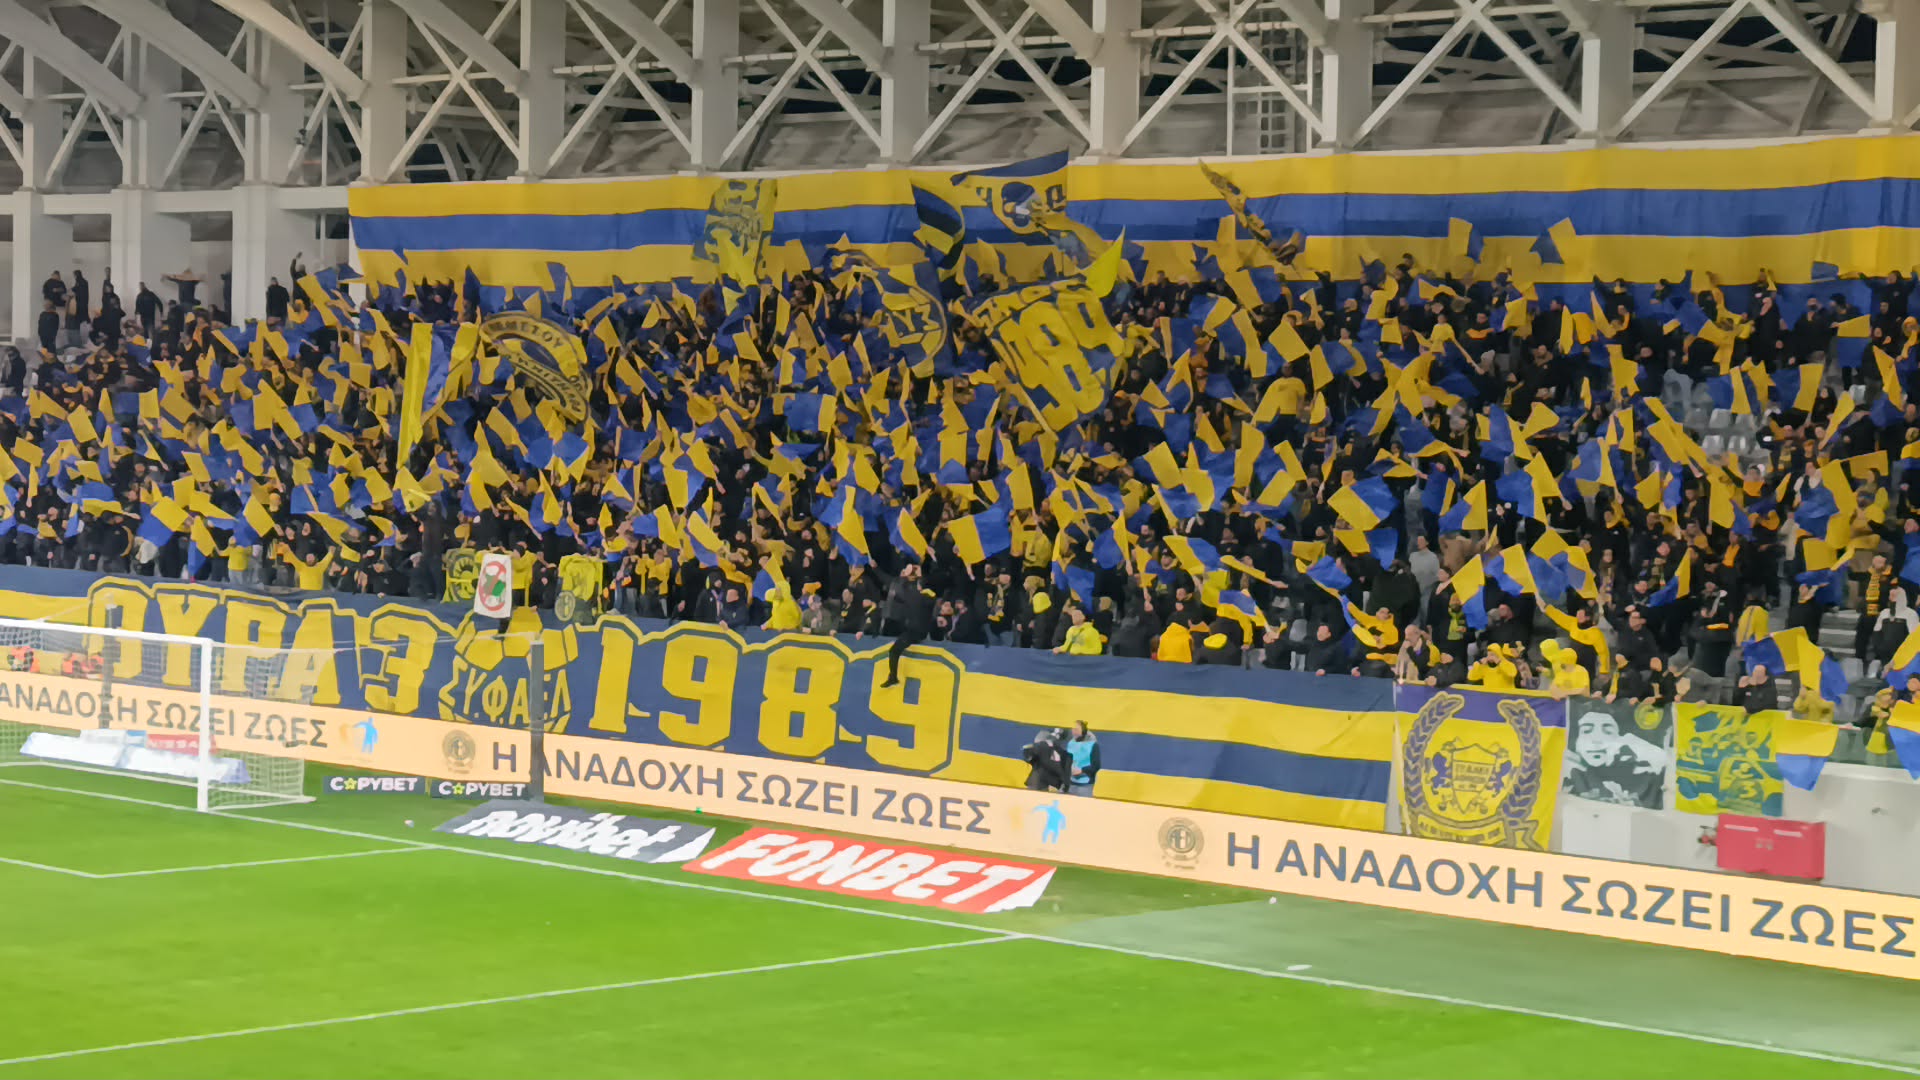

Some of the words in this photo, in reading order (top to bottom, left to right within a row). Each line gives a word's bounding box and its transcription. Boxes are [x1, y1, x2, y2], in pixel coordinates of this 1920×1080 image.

[147, 700, 235, 736] ΣΩΖΕΙ
[244, 711, 328, 748] ΖΩΕΣ
[364, 614, 438, 714] 3
[589, 622, 960, 773] 1989
[493, 741, 517, 772] Η
[736, 770, 858, 816] ΣΩΖΕΙ
[873, 789, 991, 835] ΖΩΕΣ
[701, 833, 1034, 904] FONBET
[1227, 831, 1260, 869] Η
[1275, 839, 1543, 907] ΑΝΑΔΟΧΗ
[1561, 874, 1730, 932] ΣΩΖΕΙ
[1750, 898, 1916, 958] ΖΩΕΣ
